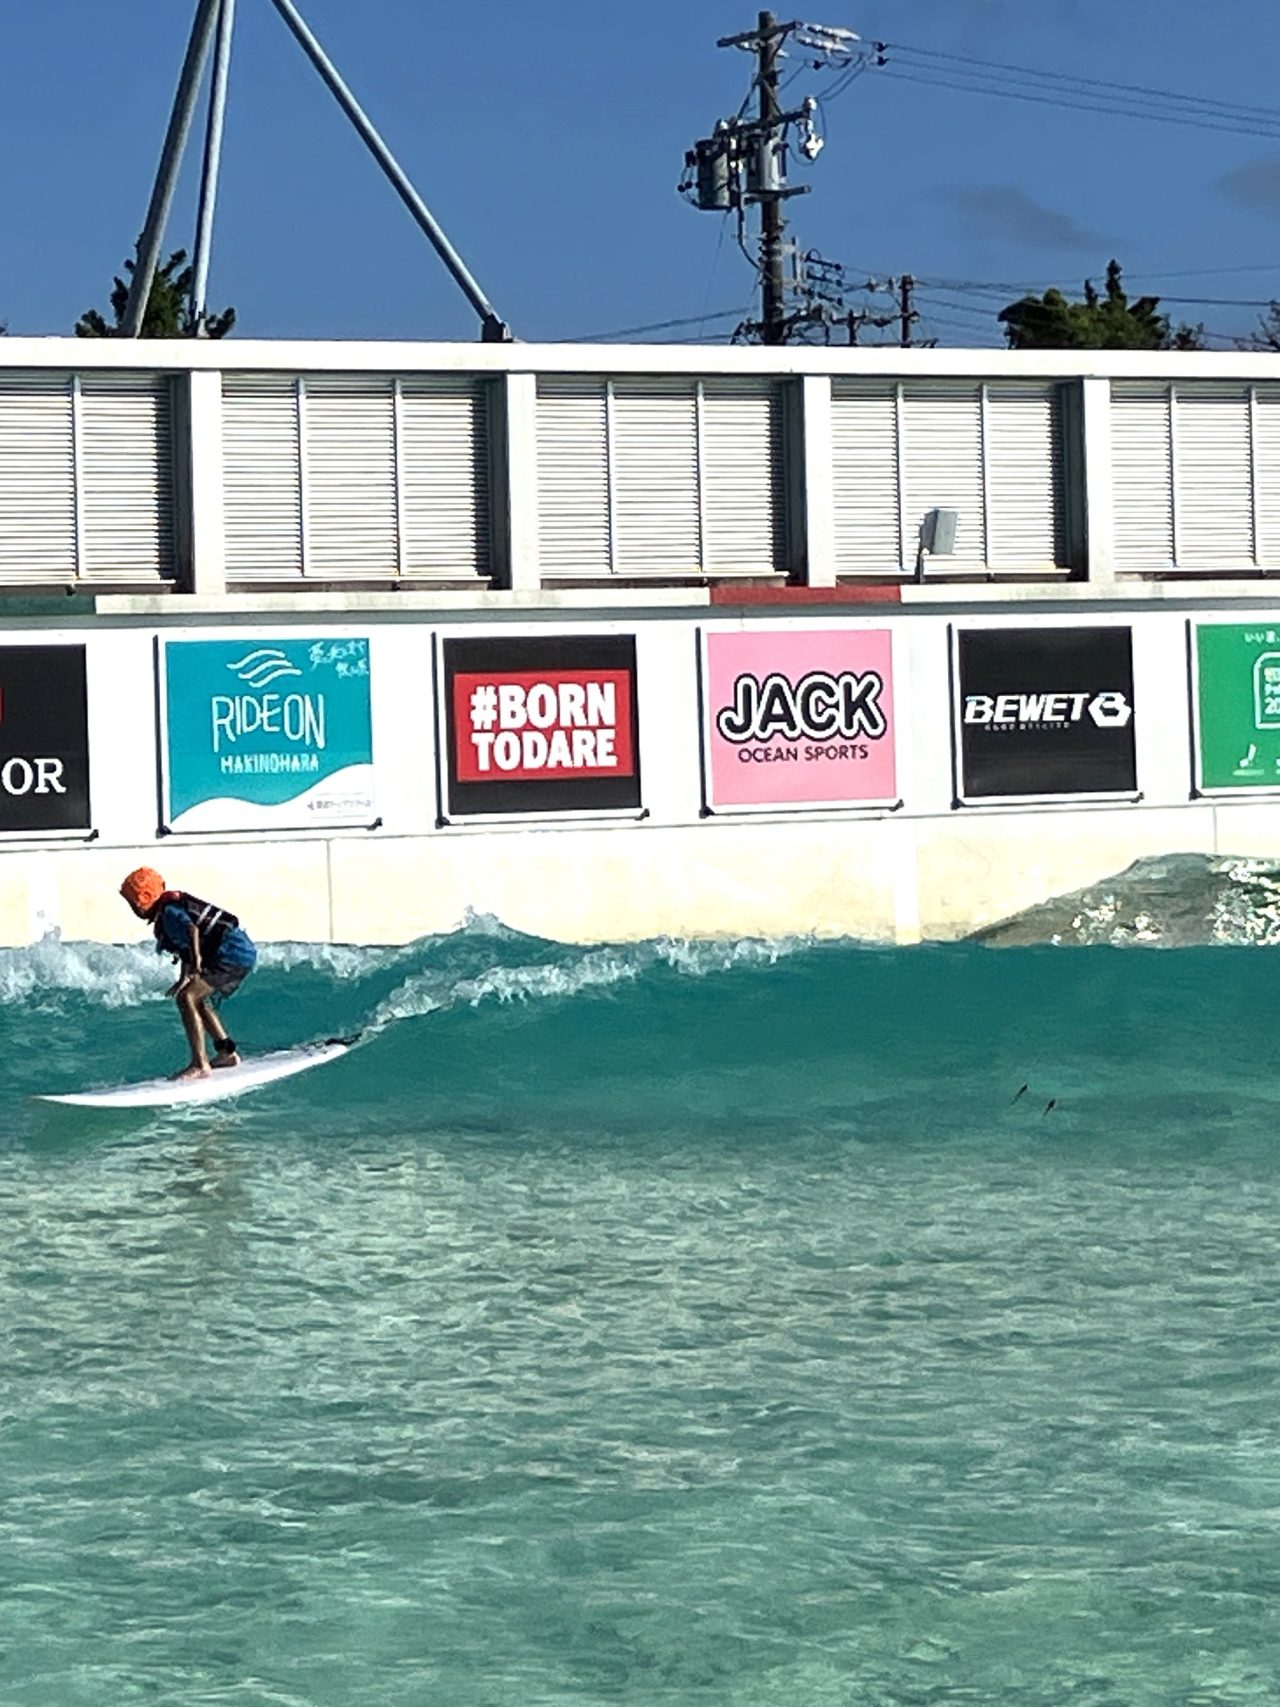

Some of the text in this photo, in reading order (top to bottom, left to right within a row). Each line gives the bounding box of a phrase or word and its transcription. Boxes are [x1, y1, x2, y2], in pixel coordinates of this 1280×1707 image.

[470, 682, 616, 730] #BORN
[716, 671, 888, 744] JACK
[964, 692, 1090, 723] BEWET
[220, 752, 319, 775] MAKINOHARA
[737, 744, 869, 763] OCEAN SPORTS
